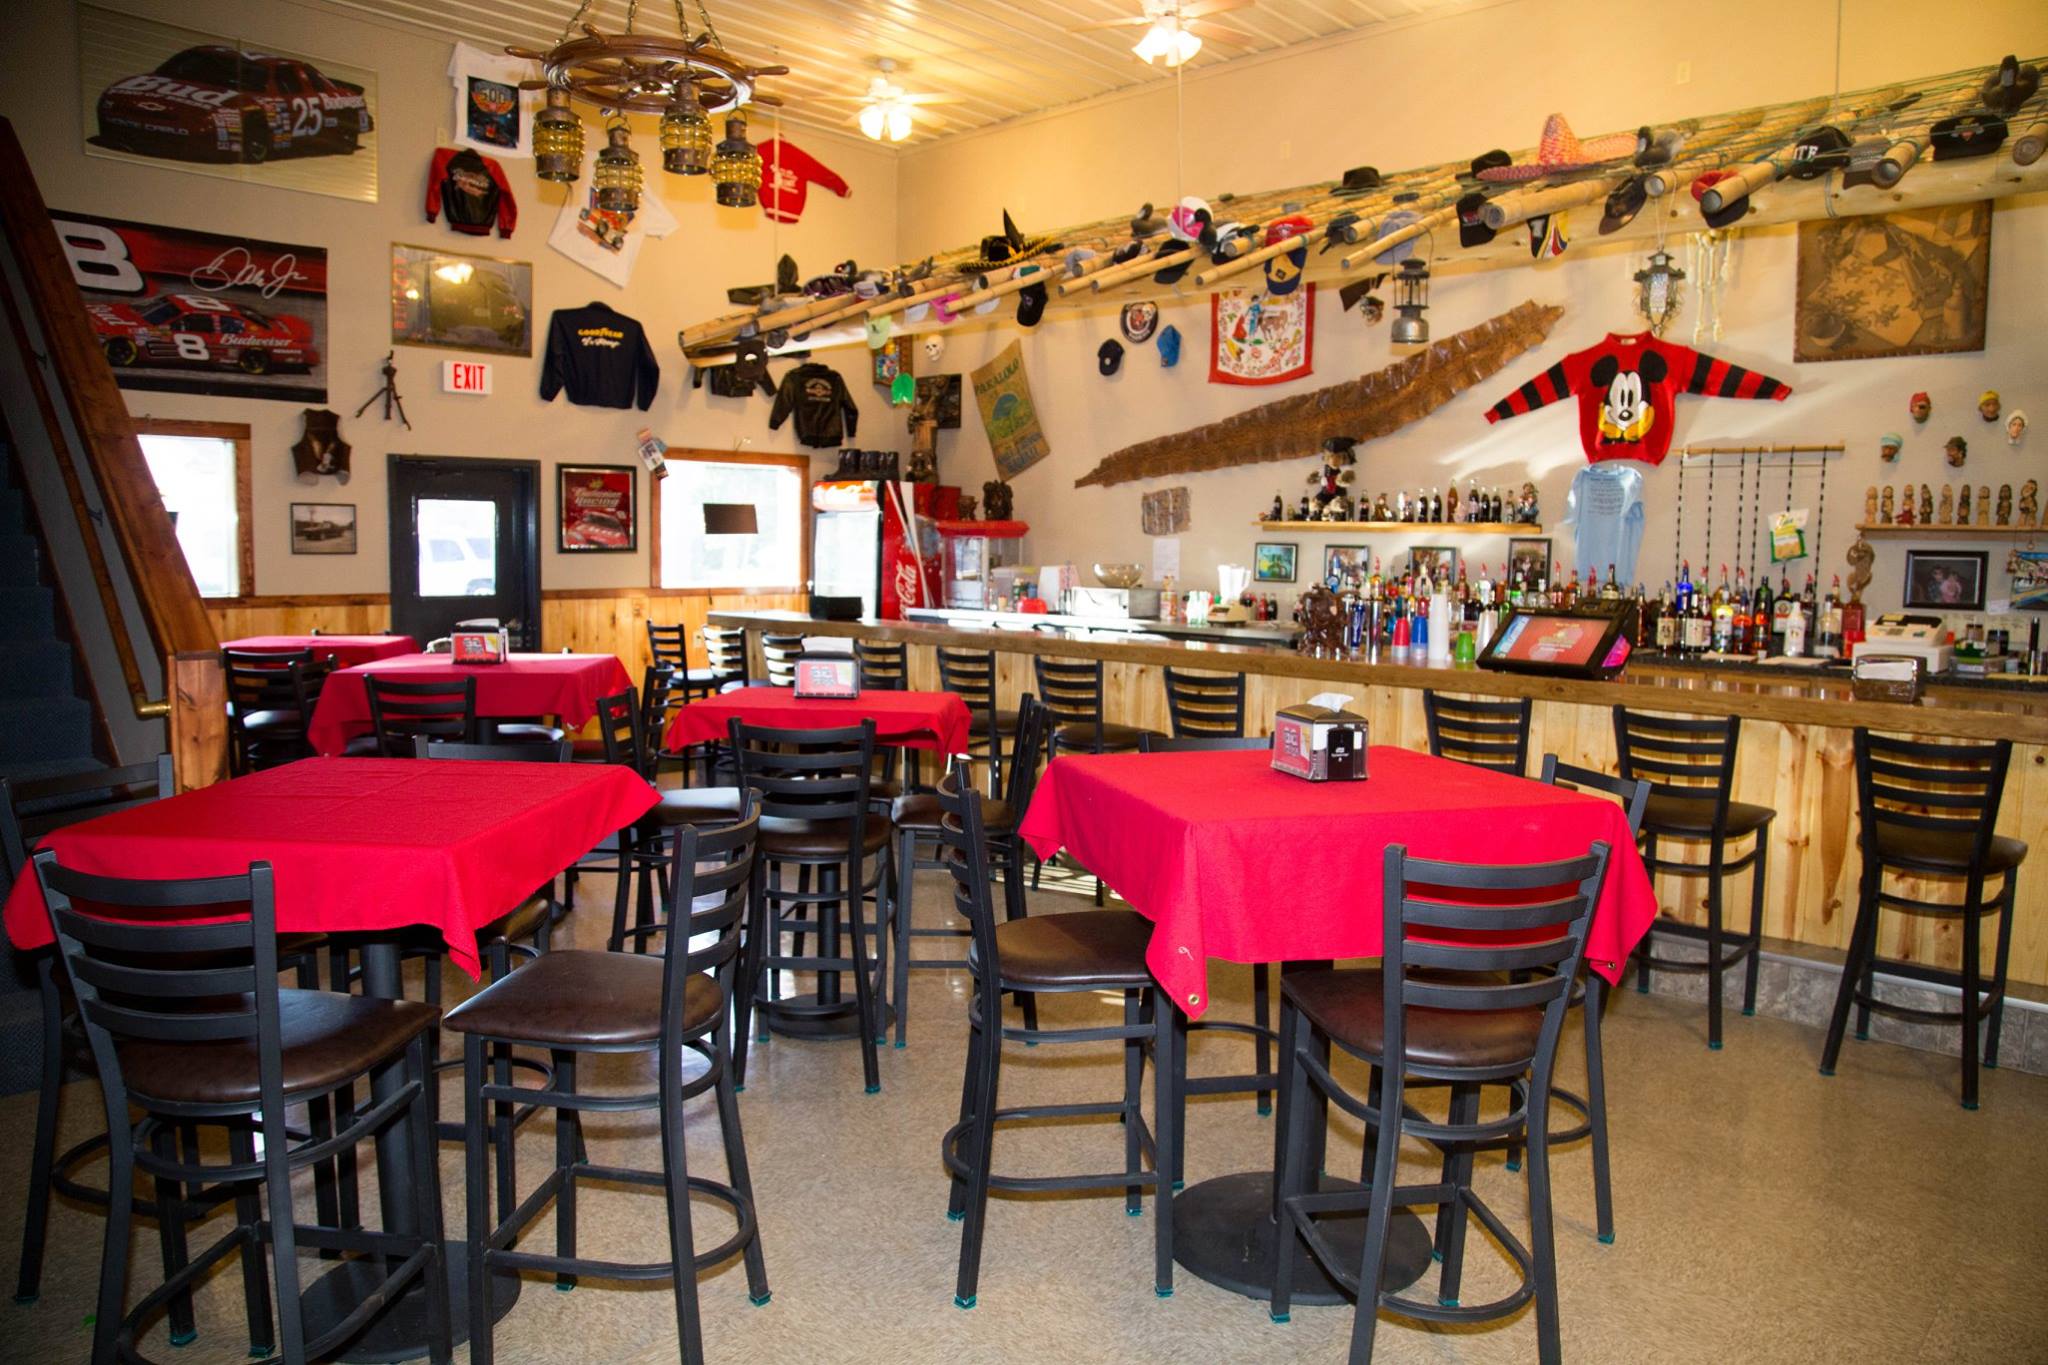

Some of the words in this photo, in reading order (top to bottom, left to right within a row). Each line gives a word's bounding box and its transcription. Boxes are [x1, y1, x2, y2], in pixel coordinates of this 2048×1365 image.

[112, 75, 241, 107] Bud
[292, 97, 323, 137] 25
[52, 219, 144, 292] 8
[173, 333, 210, 361] 8
[219, 332, 292, 347] Budweiser
[453, 363, 486, 391] EXIT
